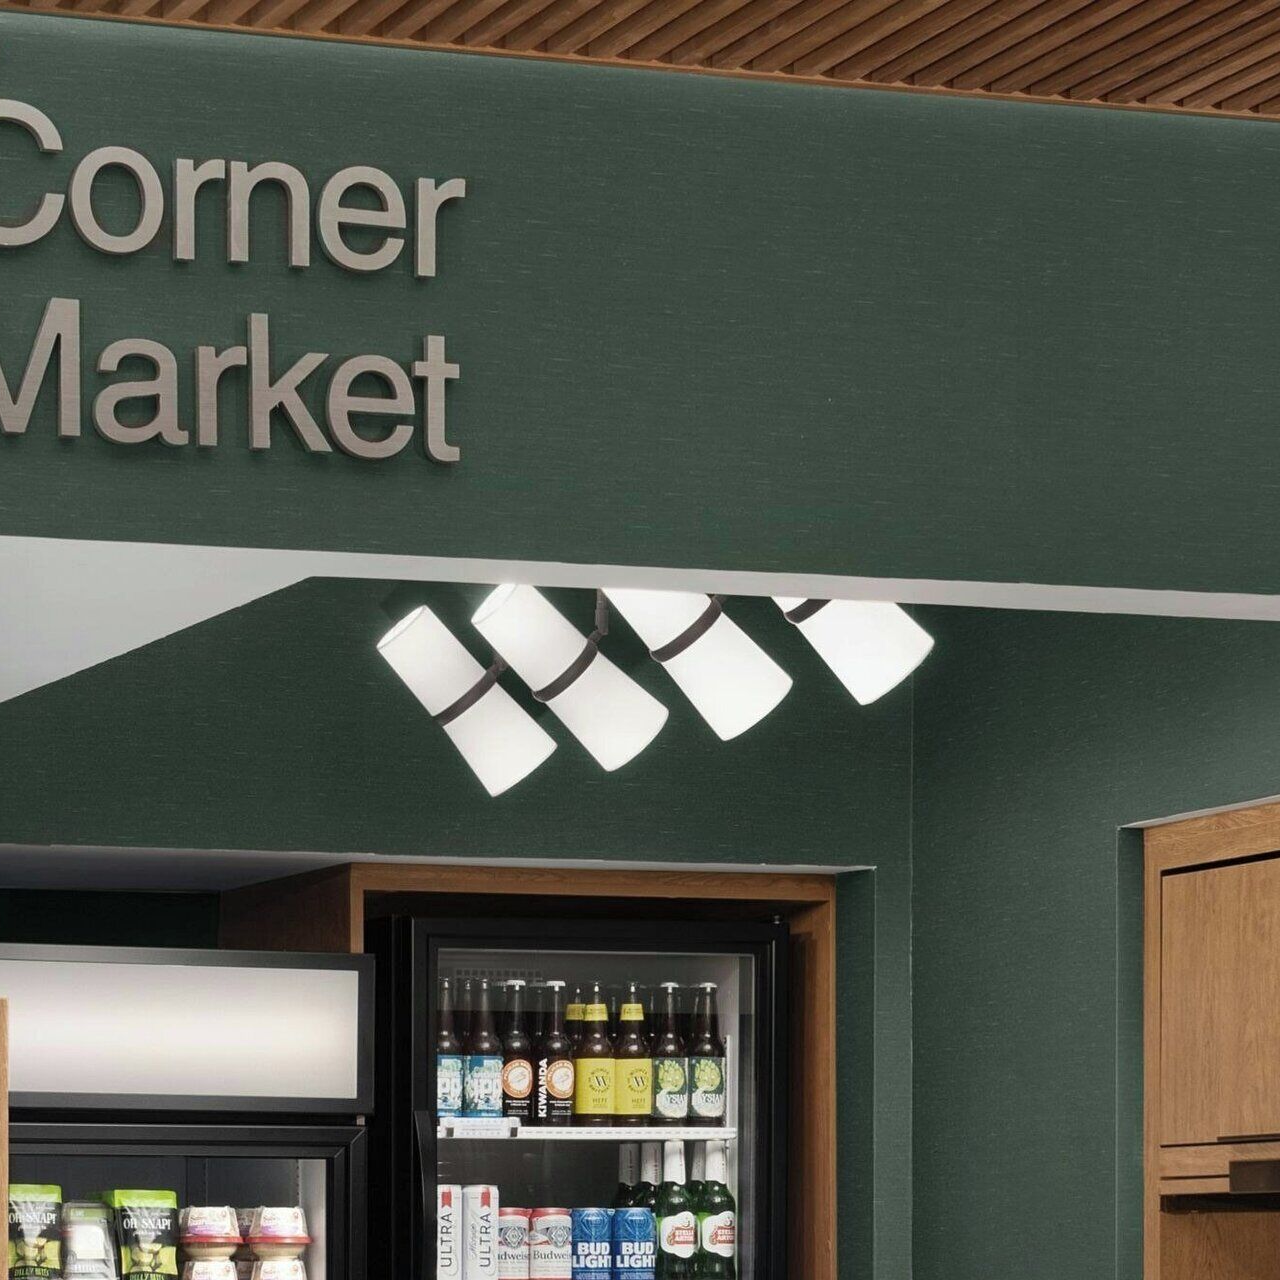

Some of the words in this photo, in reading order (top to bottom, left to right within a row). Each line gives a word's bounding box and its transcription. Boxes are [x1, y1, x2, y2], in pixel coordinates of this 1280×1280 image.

[537, 1058, 548, 1117] KIWANDA
[440, 1212, 453, 1268] ULTRA
[479, 1212, 491, 1268] ULTRA
[577, 1242, 610, 1255] BUD
[622, 1242, 654, 1255] BUD
